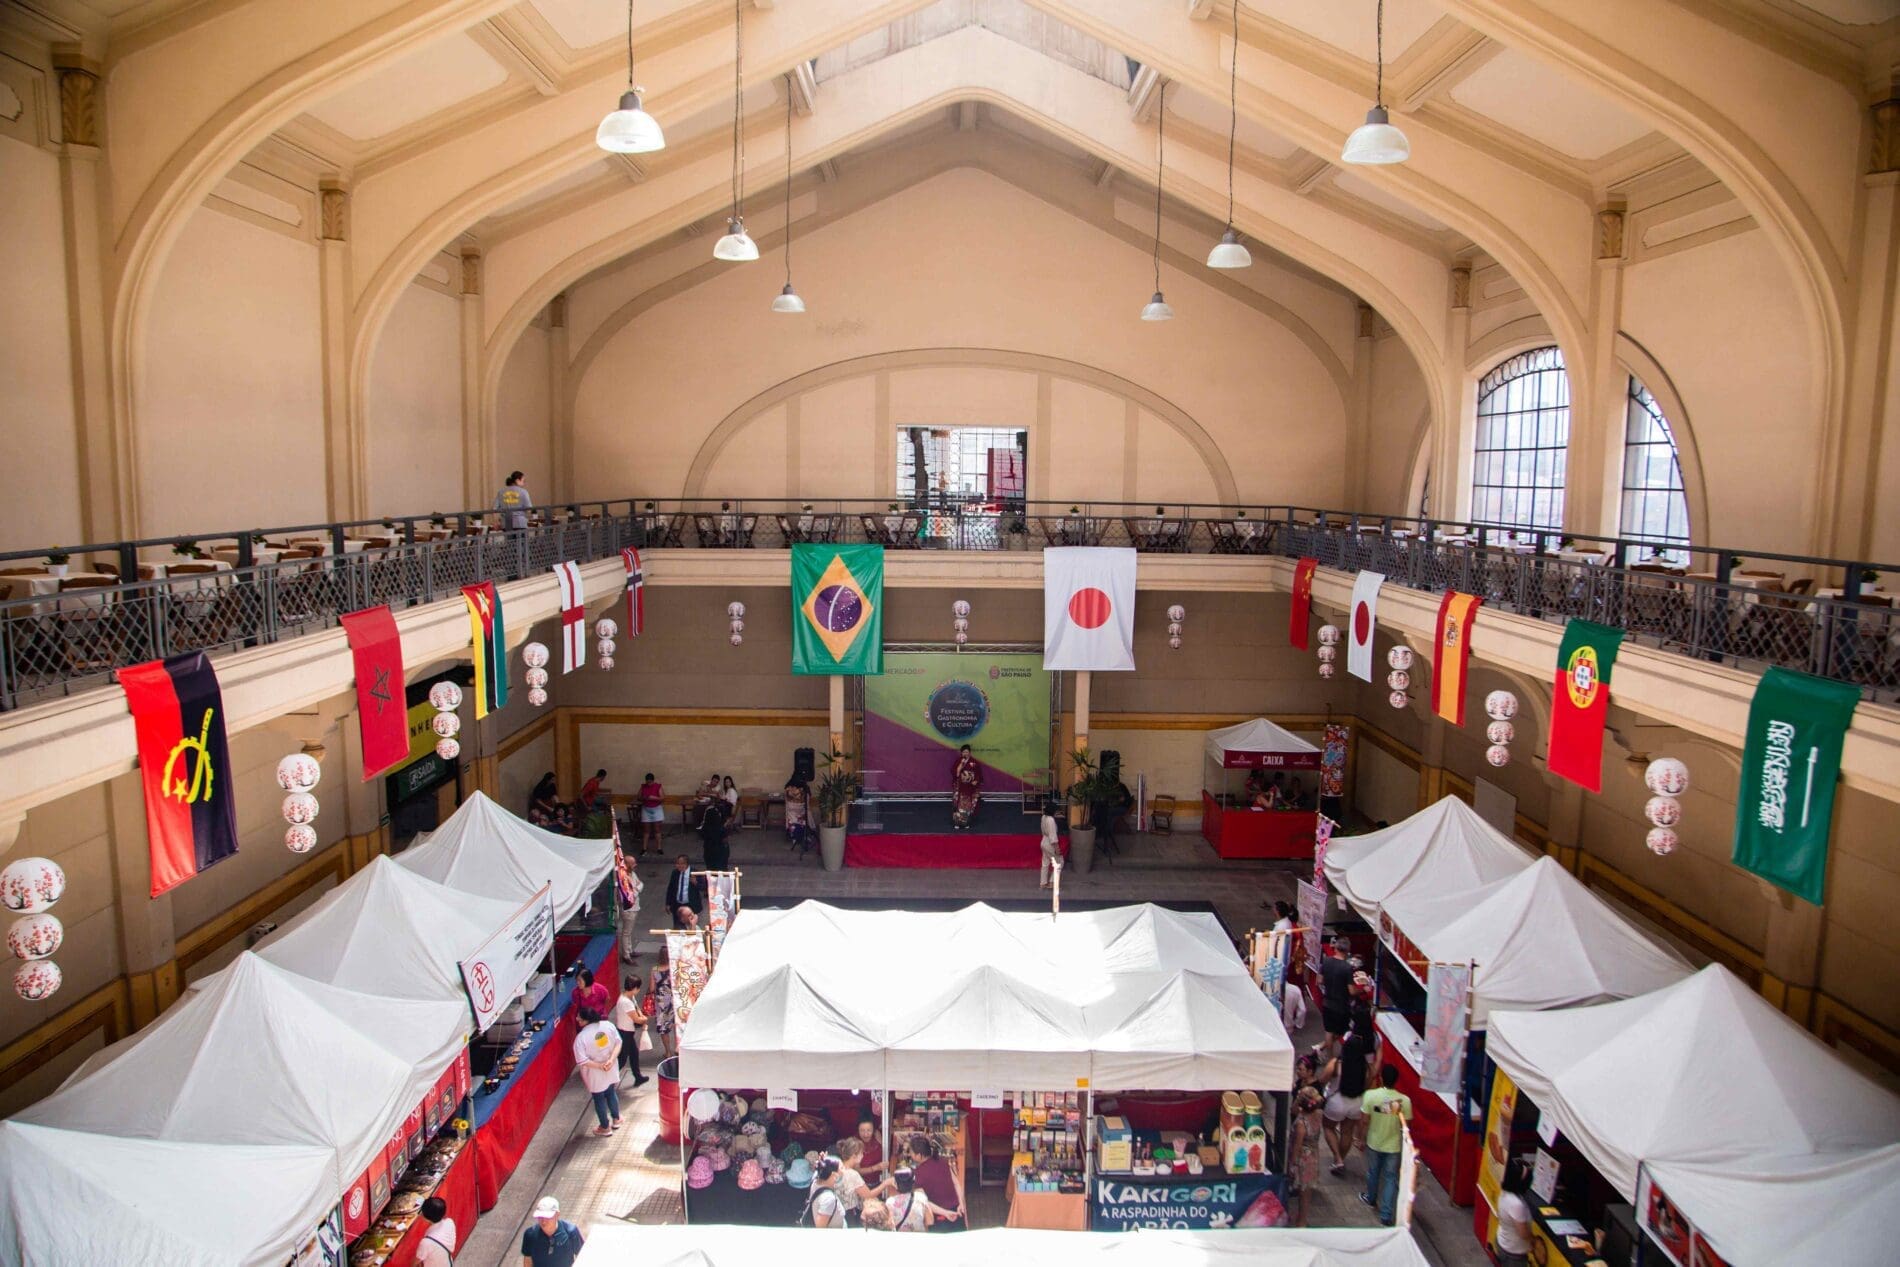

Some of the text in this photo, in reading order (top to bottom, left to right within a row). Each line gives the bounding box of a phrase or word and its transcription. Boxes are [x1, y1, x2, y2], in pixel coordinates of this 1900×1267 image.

[1262, 755, 1284, 766] CAIXA
[1101, 1206, 1208, 1219] A RASPADINHA DO
